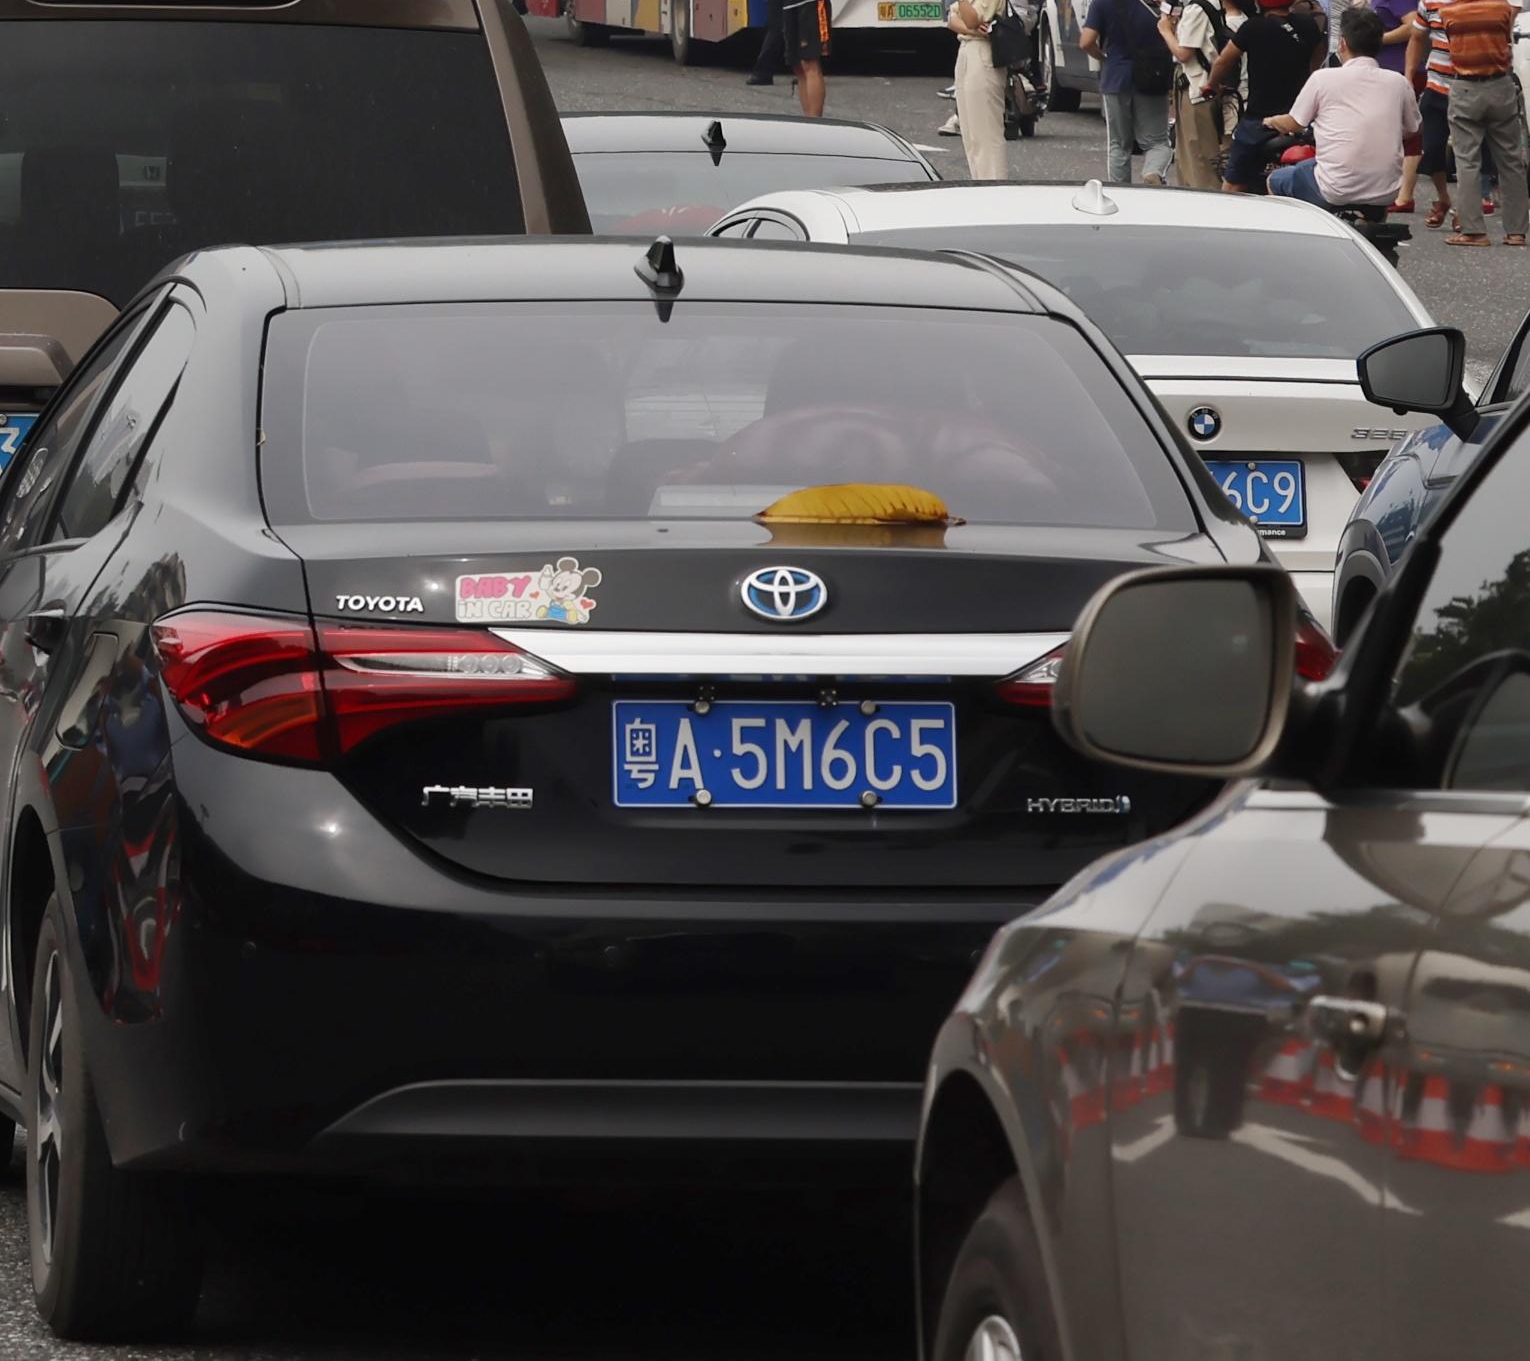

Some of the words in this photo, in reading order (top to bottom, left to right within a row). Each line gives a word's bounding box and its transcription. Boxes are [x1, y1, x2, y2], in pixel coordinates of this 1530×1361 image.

[1210, 470, 1296, 514] 6C9
[460, 576, 531, 599] BABY
[336, 595, 424, 612] TOYOTA
[488, 600, 531, 618] CAR
[1027, 797, 1115, 813] HYBRID
